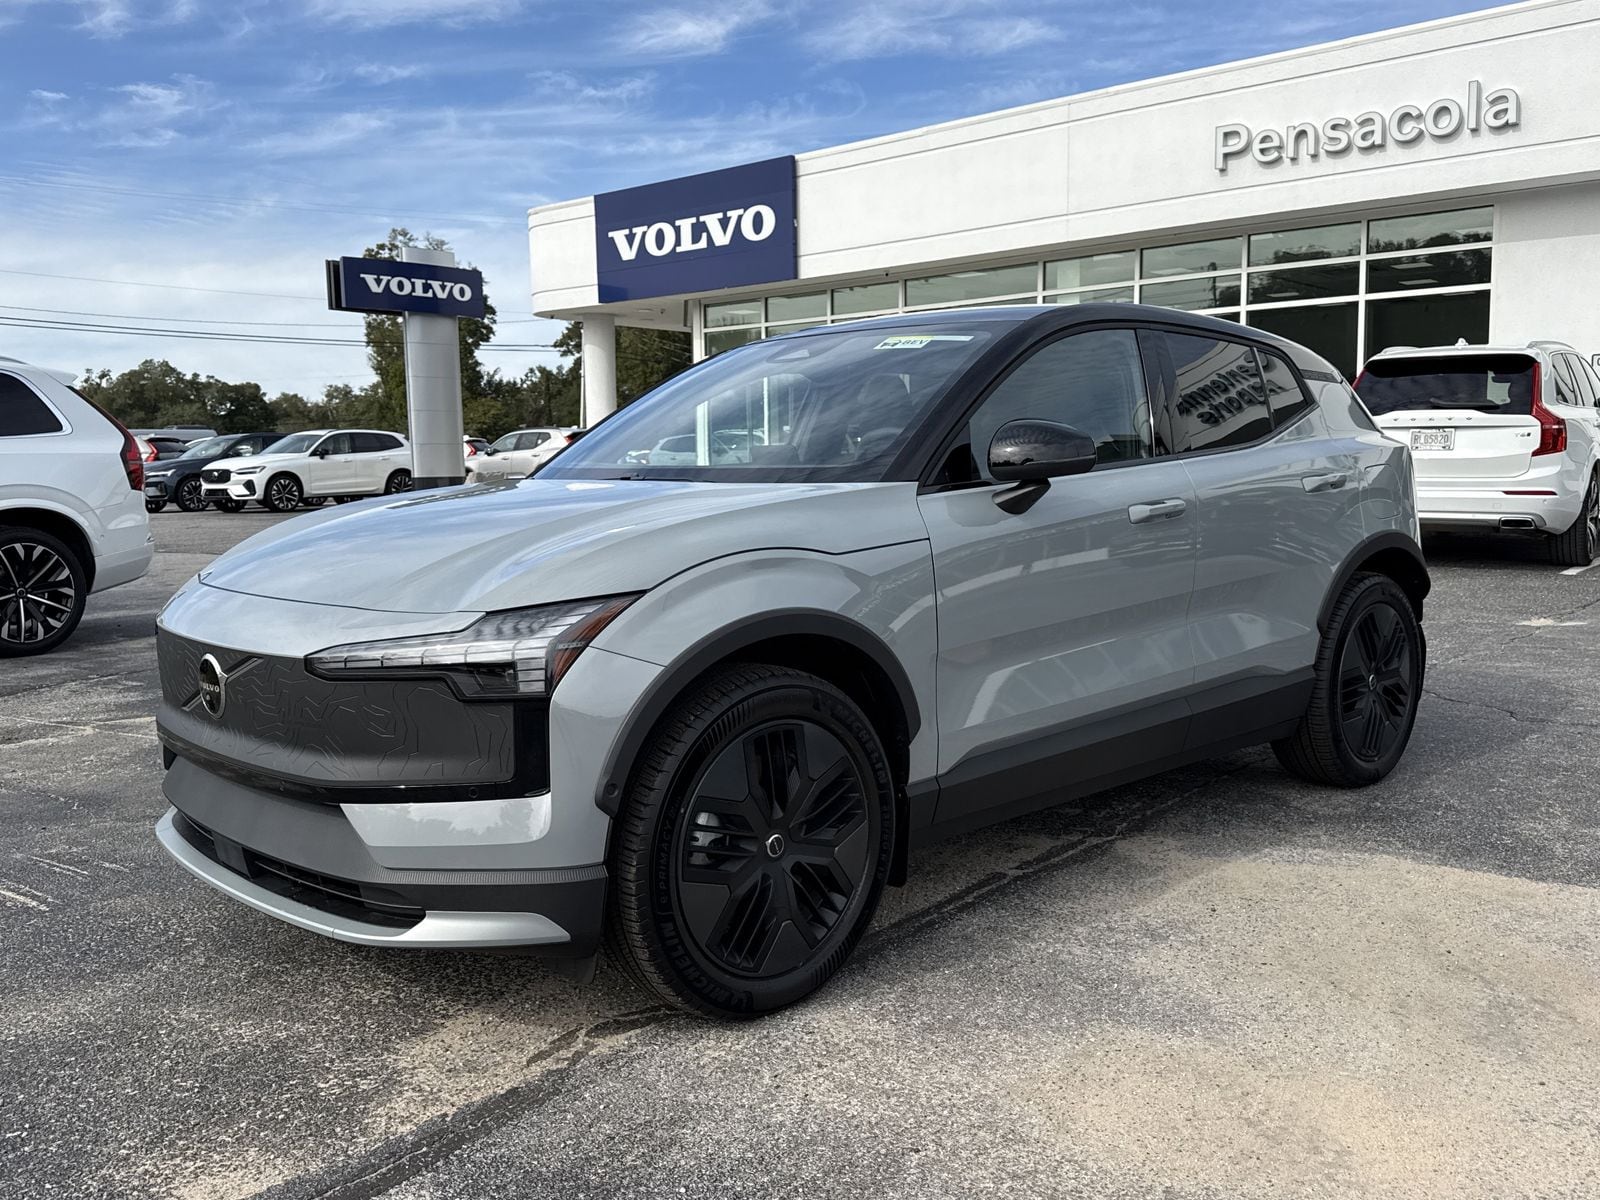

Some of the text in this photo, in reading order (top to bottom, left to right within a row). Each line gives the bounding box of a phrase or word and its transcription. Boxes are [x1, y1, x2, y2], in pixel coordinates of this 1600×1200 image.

[1214, 80, 1520, 171] Pensacola
[608, 204, 776, 261] VOLVO
[360, 273, 473, 302] VOLVO
